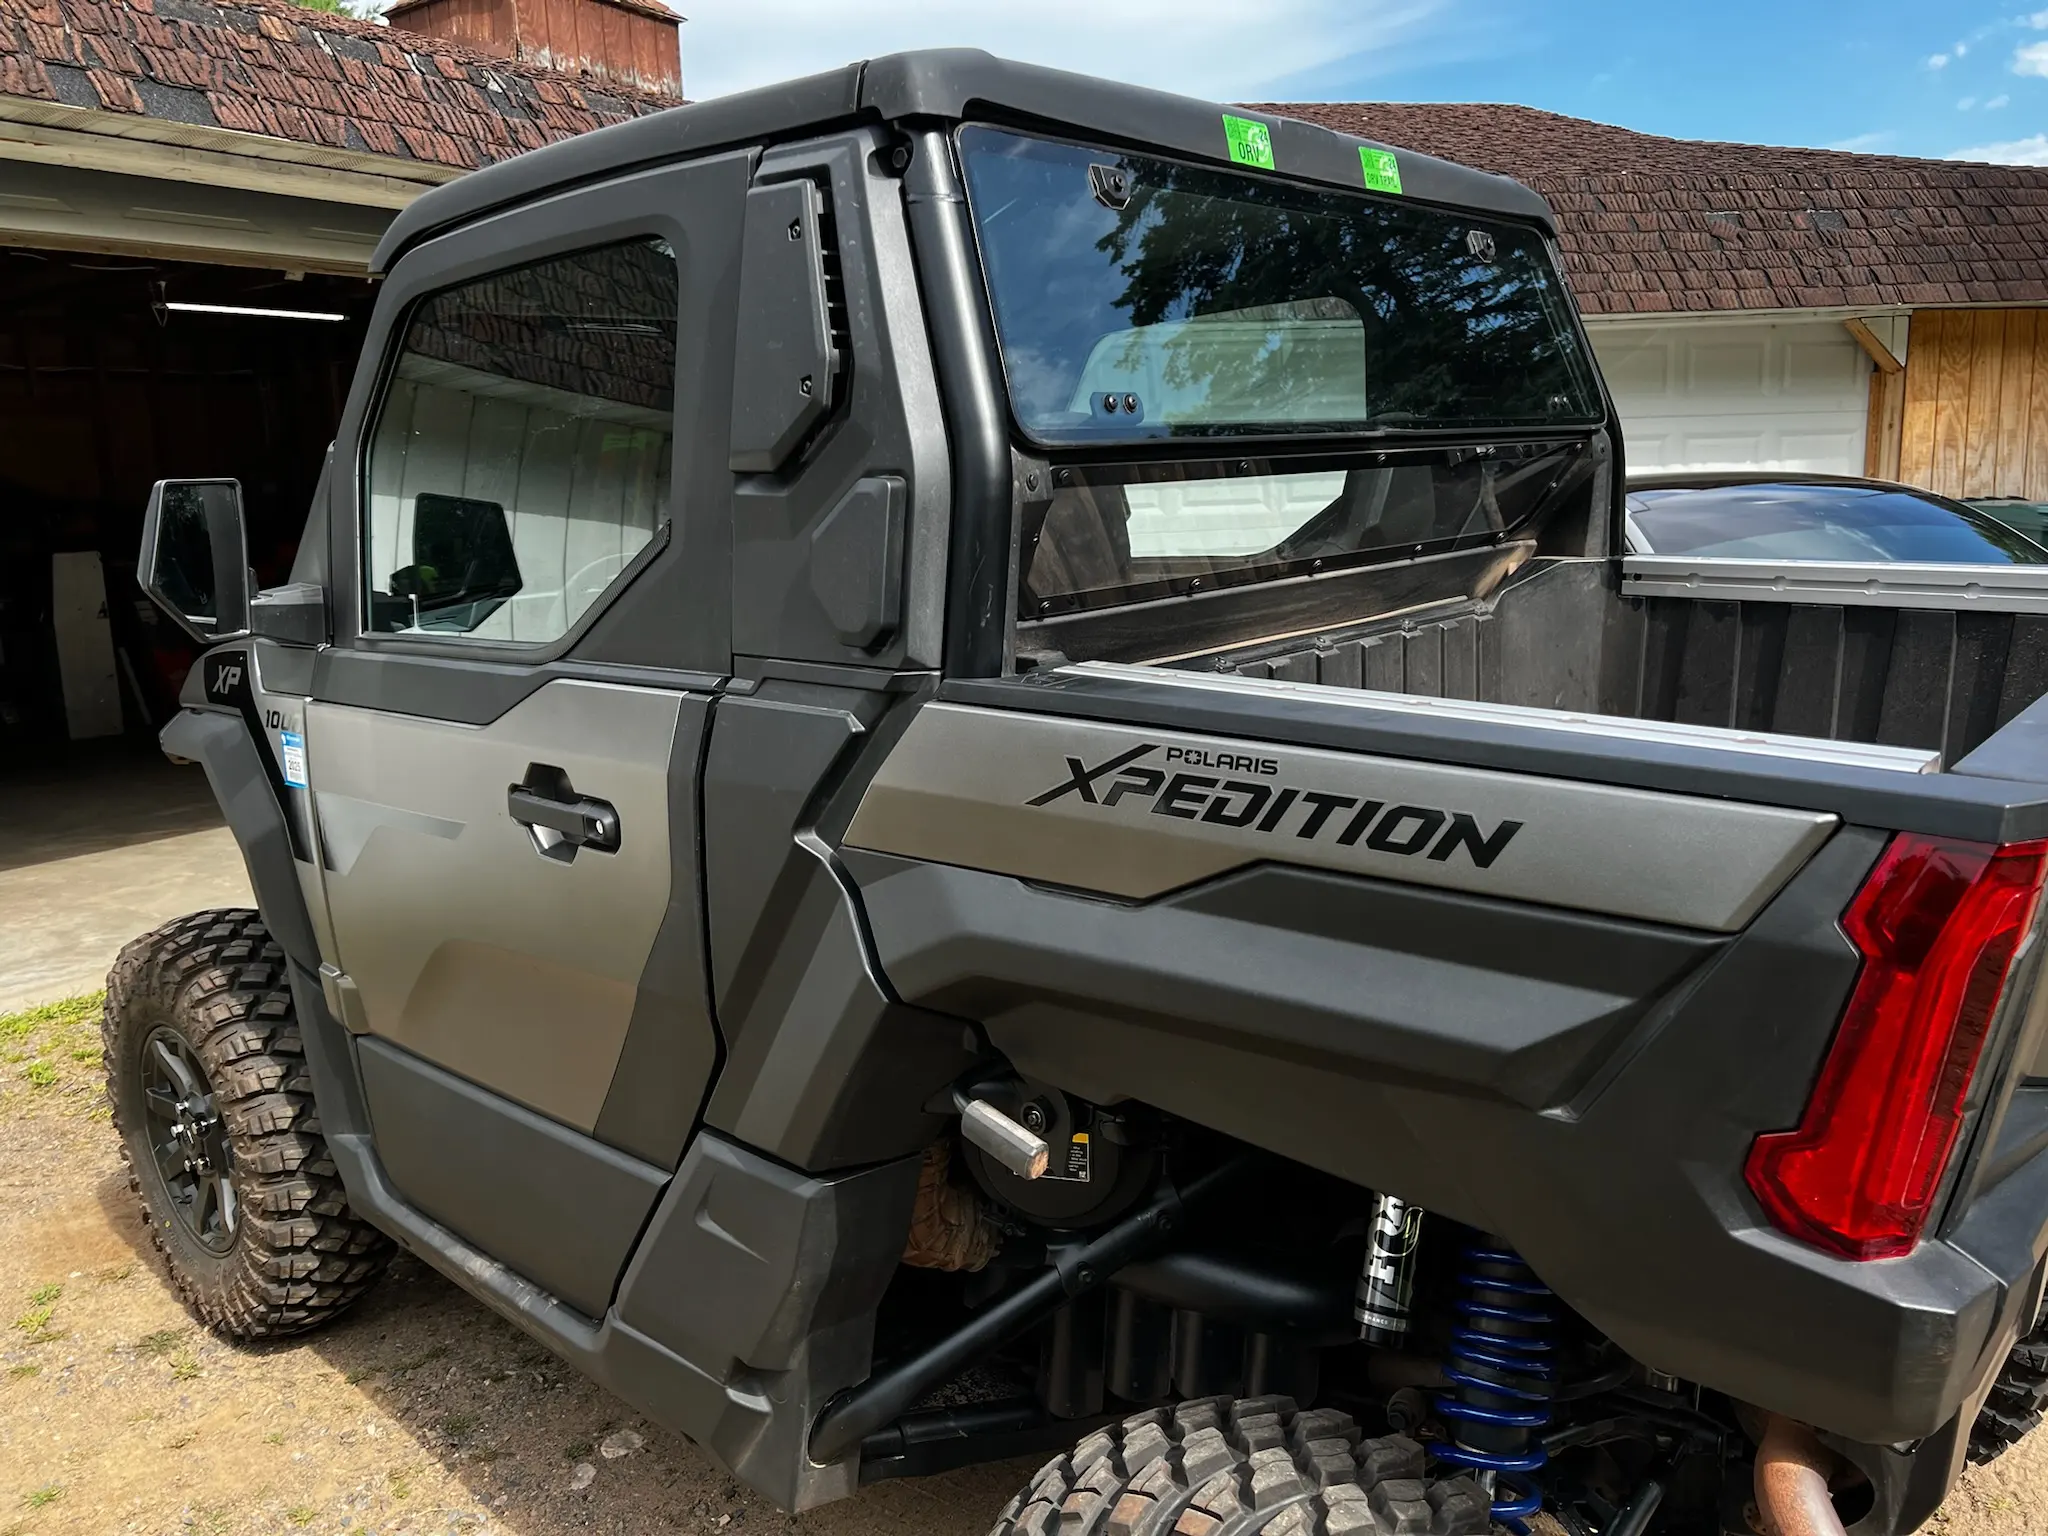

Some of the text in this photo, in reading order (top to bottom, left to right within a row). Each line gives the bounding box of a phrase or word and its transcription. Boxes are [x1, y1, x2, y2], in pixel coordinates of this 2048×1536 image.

[1238, 142, 1259, 162] ORV
[212, 665, 242, 694] XP
[1166, 747, 1278, 776] POLARIS
[1024, 744, 1524, 869] XPEDITION
